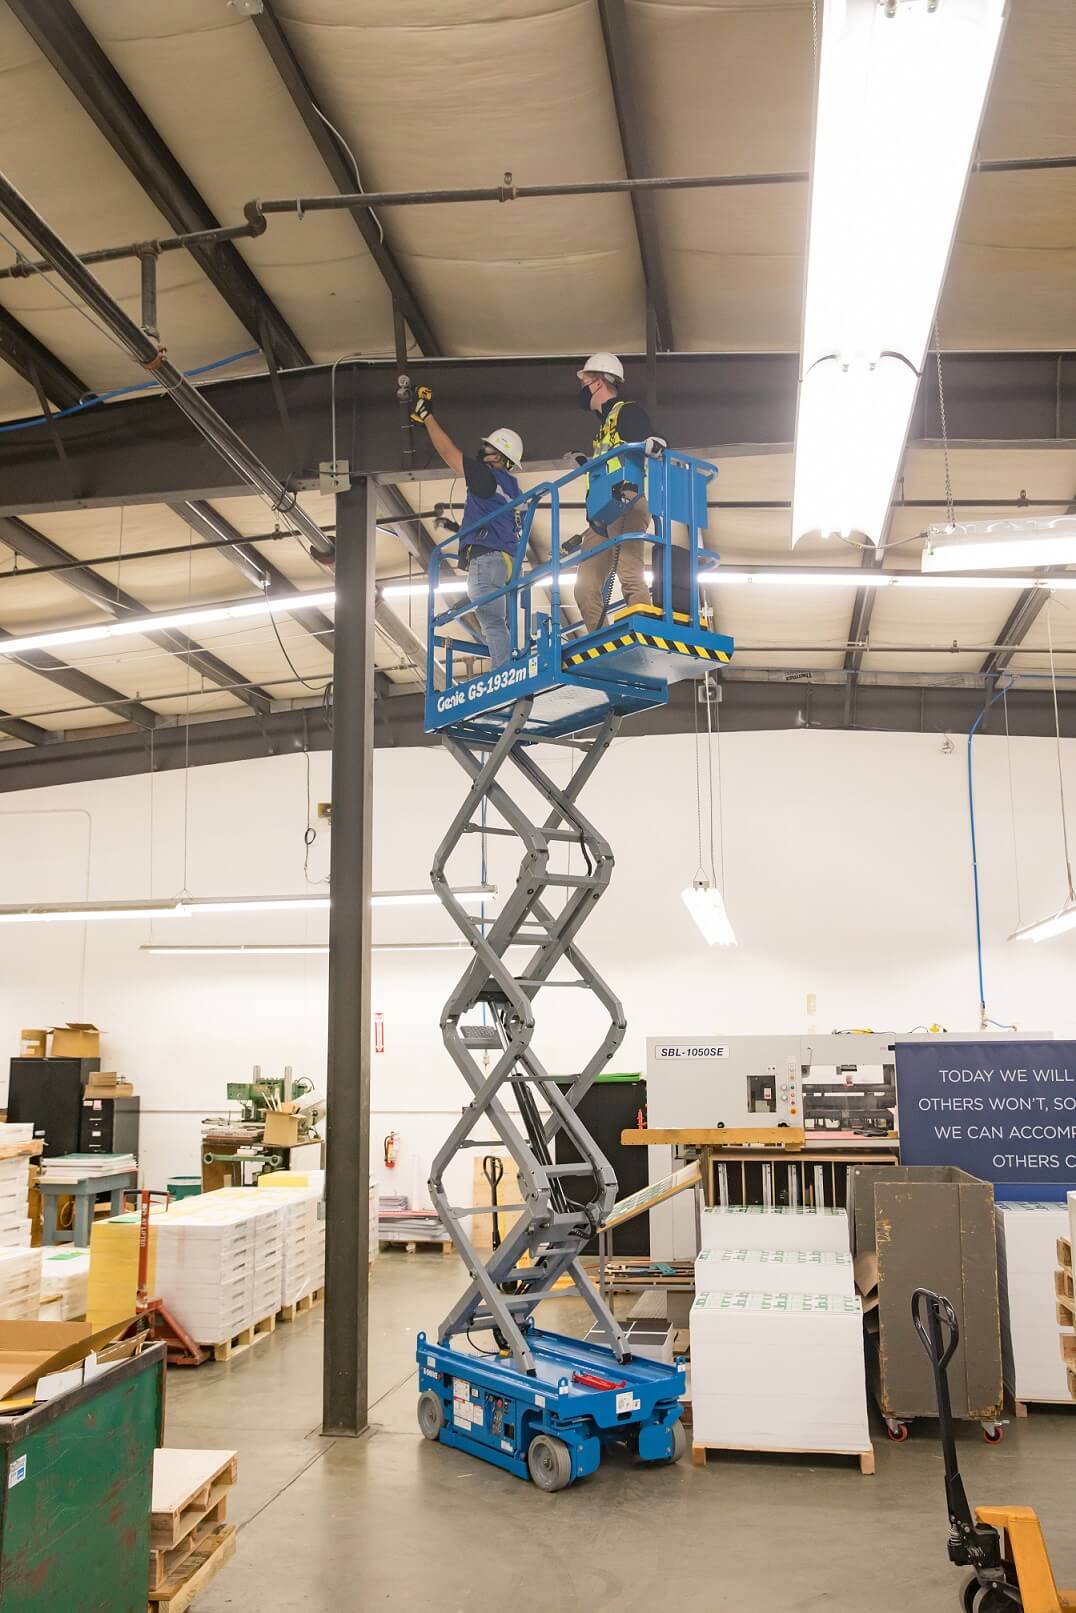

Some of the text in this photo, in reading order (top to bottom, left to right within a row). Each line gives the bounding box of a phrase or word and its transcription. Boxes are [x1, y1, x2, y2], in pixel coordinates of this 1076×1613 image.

[437, 691, 466, 712] Genie
[468, 667, 527, 700] GS-1932m
[661, 1047, 724, 1057] SBL-1050SE
[939, 1068, 1075, 1083] TODAY WE WILL
[918, 1097, 984, 1111] OTHERS
[988, 1097, 1049, 1112] WON'T,
[934, 1126, 962, 1139] WE
[967, 1126, 1004, 1139] CAN
[992, 1154, 1060, 1168] OTHERS
